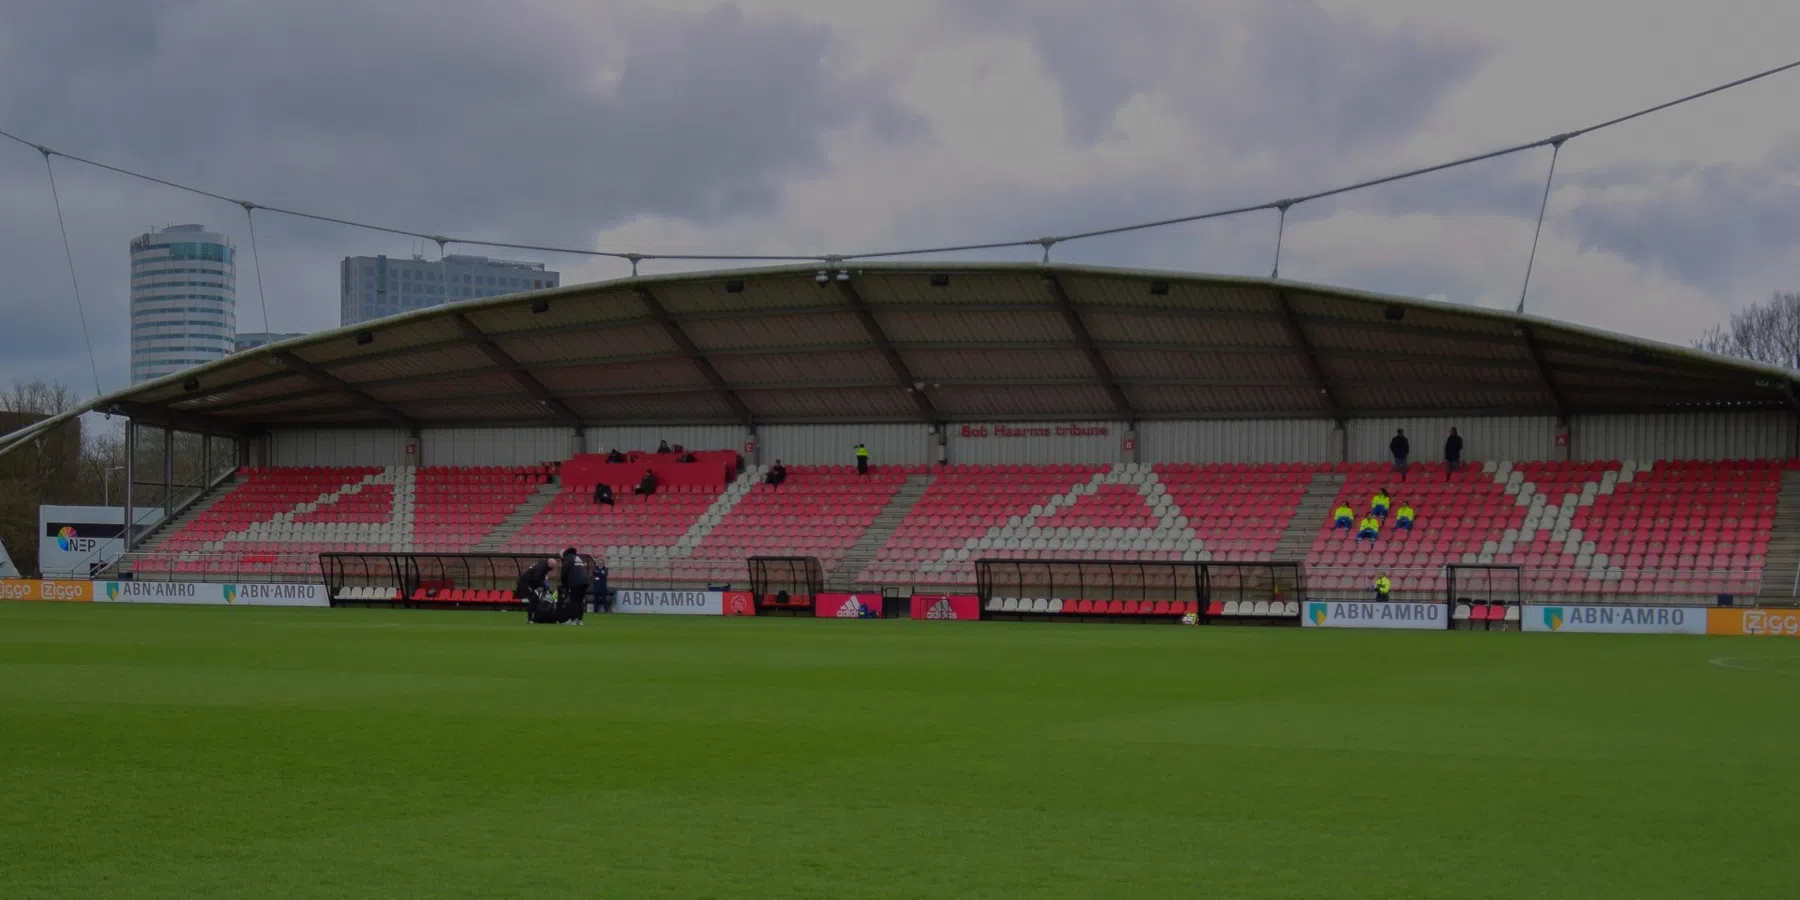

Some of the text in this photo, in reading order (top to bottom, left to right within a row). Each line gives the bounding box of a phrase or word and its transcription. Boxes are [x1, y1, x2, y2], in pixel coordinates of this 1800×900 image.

[961, 424, 1108, 437] Bob Haarms tribune
[69, 539, 96, 552] NEP
